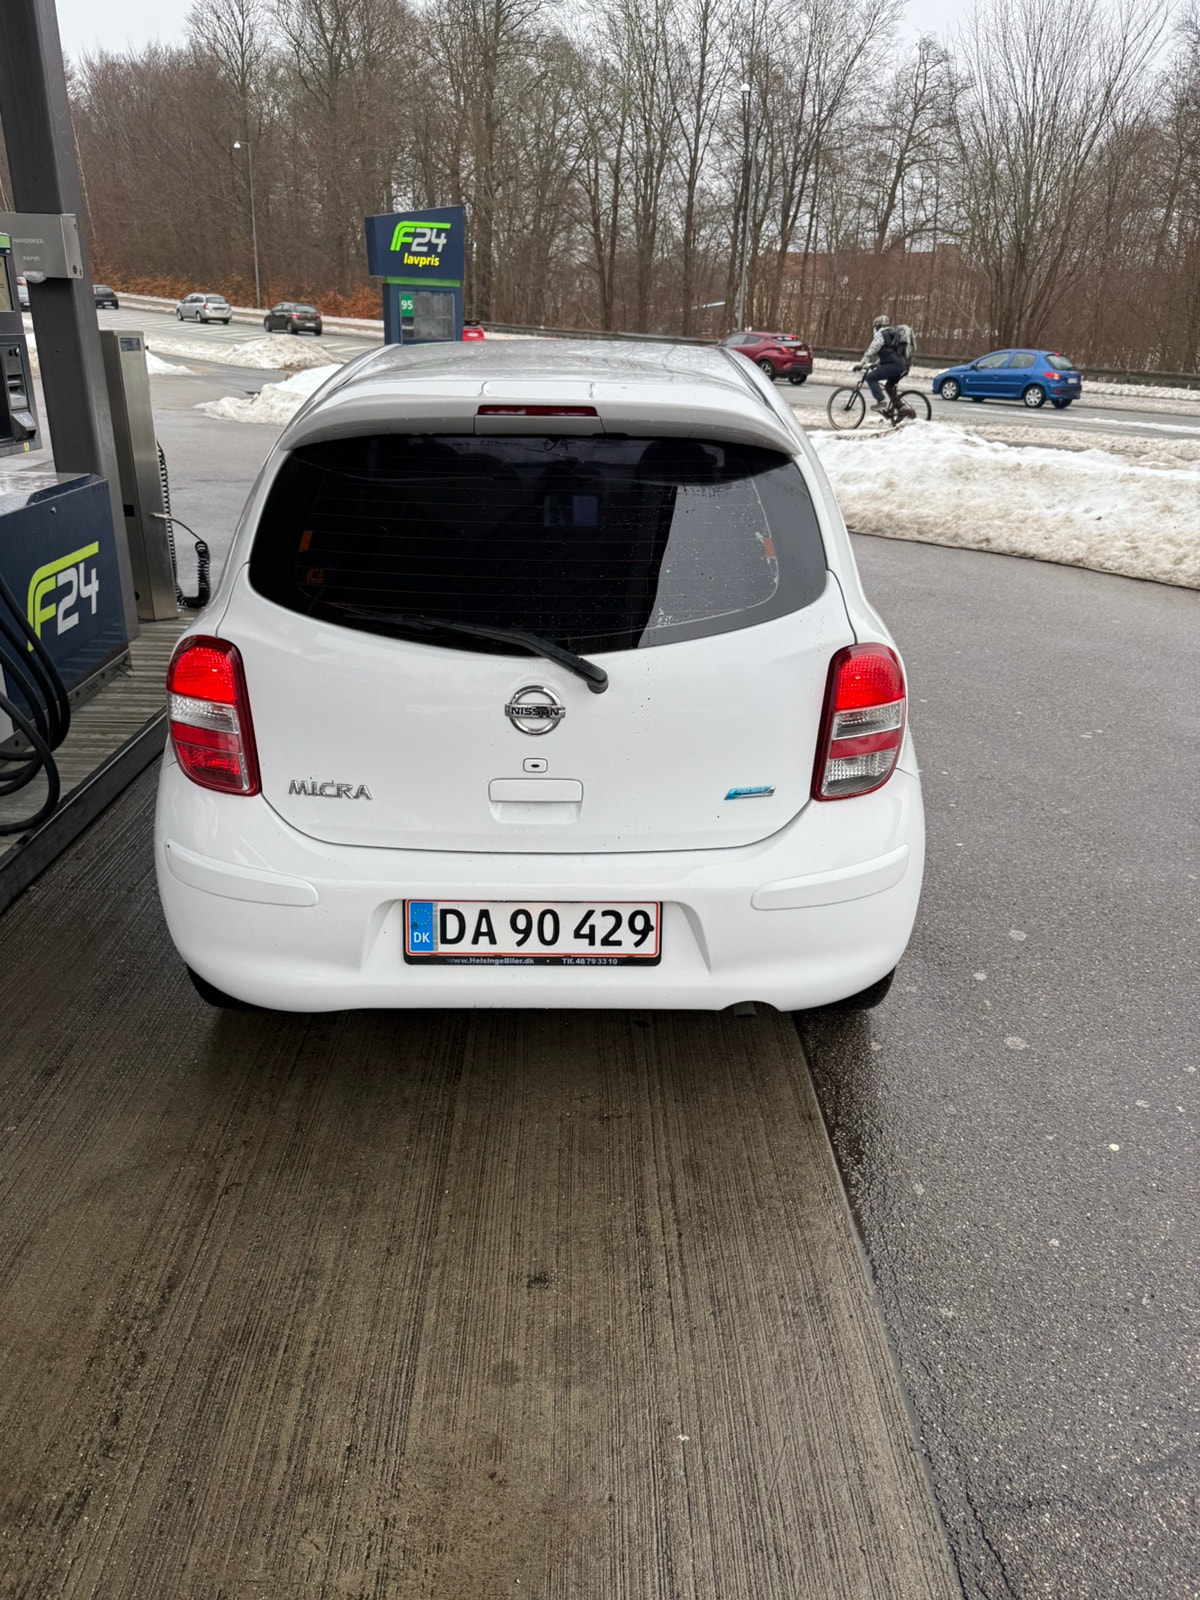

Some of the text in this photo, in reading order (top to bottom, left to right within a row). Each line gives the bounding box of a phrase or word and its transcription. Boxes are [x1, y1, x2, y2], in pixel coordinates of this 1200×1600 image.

[390, 221, 451, 253] F24
[403, 252, 440, 267] lavpris
[401, 300, 413, 310] 95
[27, 541, 99, 652] F24
[511, 707, 559, 718] NISSAN
[288, 780, 373, 800] MICRA
[440, 909, 655, 948] DA 90 429
[413, 932, 430, 943] DK
